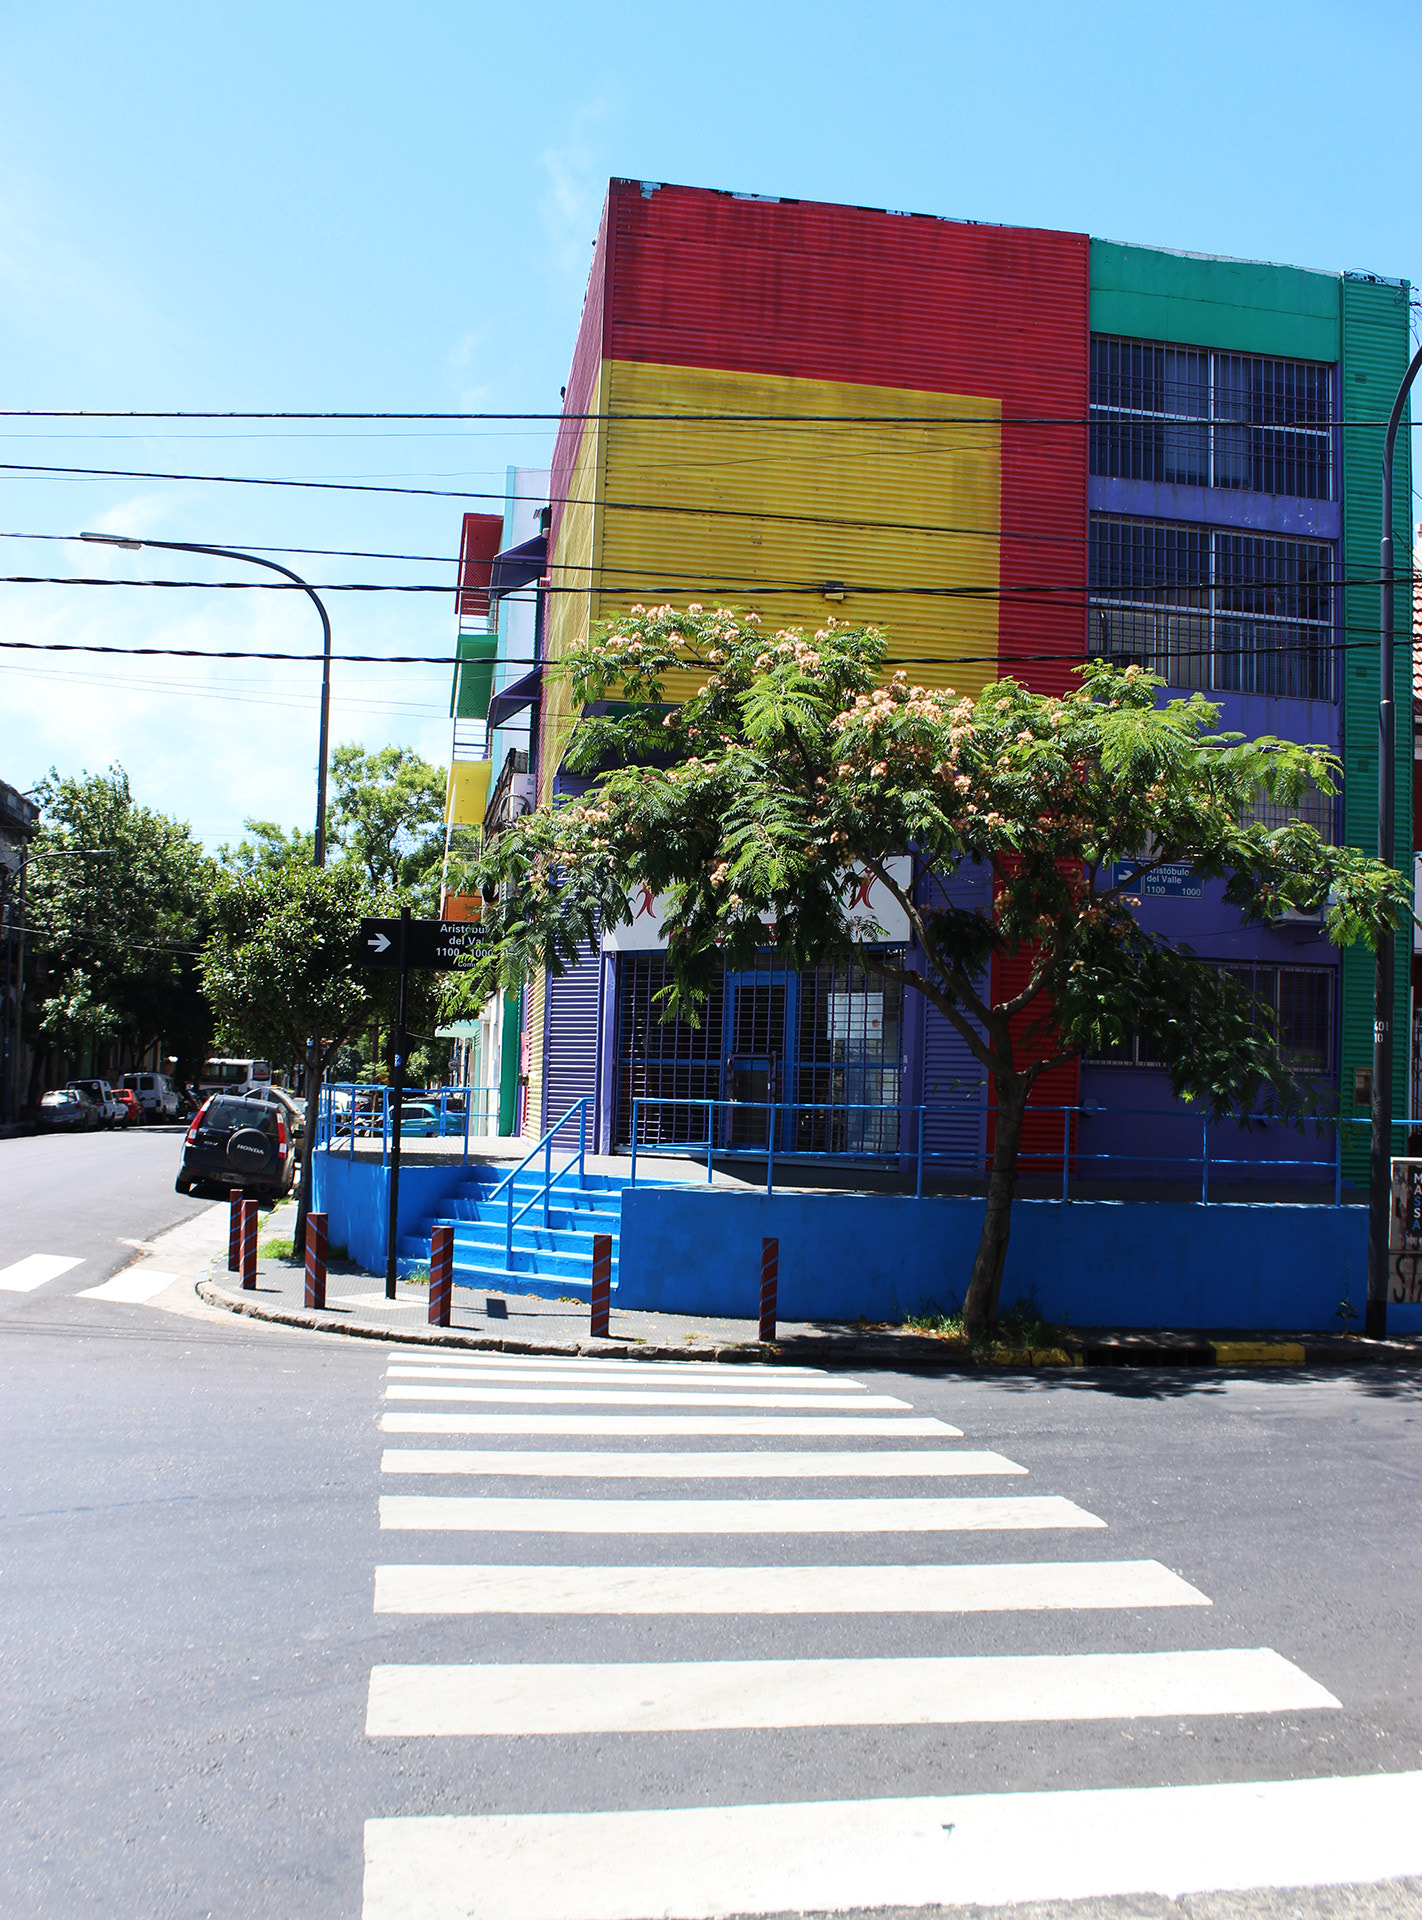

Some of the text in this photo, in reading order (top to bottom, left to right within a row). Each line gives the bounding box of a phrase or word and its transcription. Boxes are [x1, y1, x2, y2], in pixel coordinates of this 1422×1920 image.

[1146, 874, 1182, 884] del Valle
[1146, 886, 1201, 897] 1100 1000
[448, 936, 465, 945] del
[436, 947, 460, 957] 1100
[236, 1143, 265, 1155] HONDA
